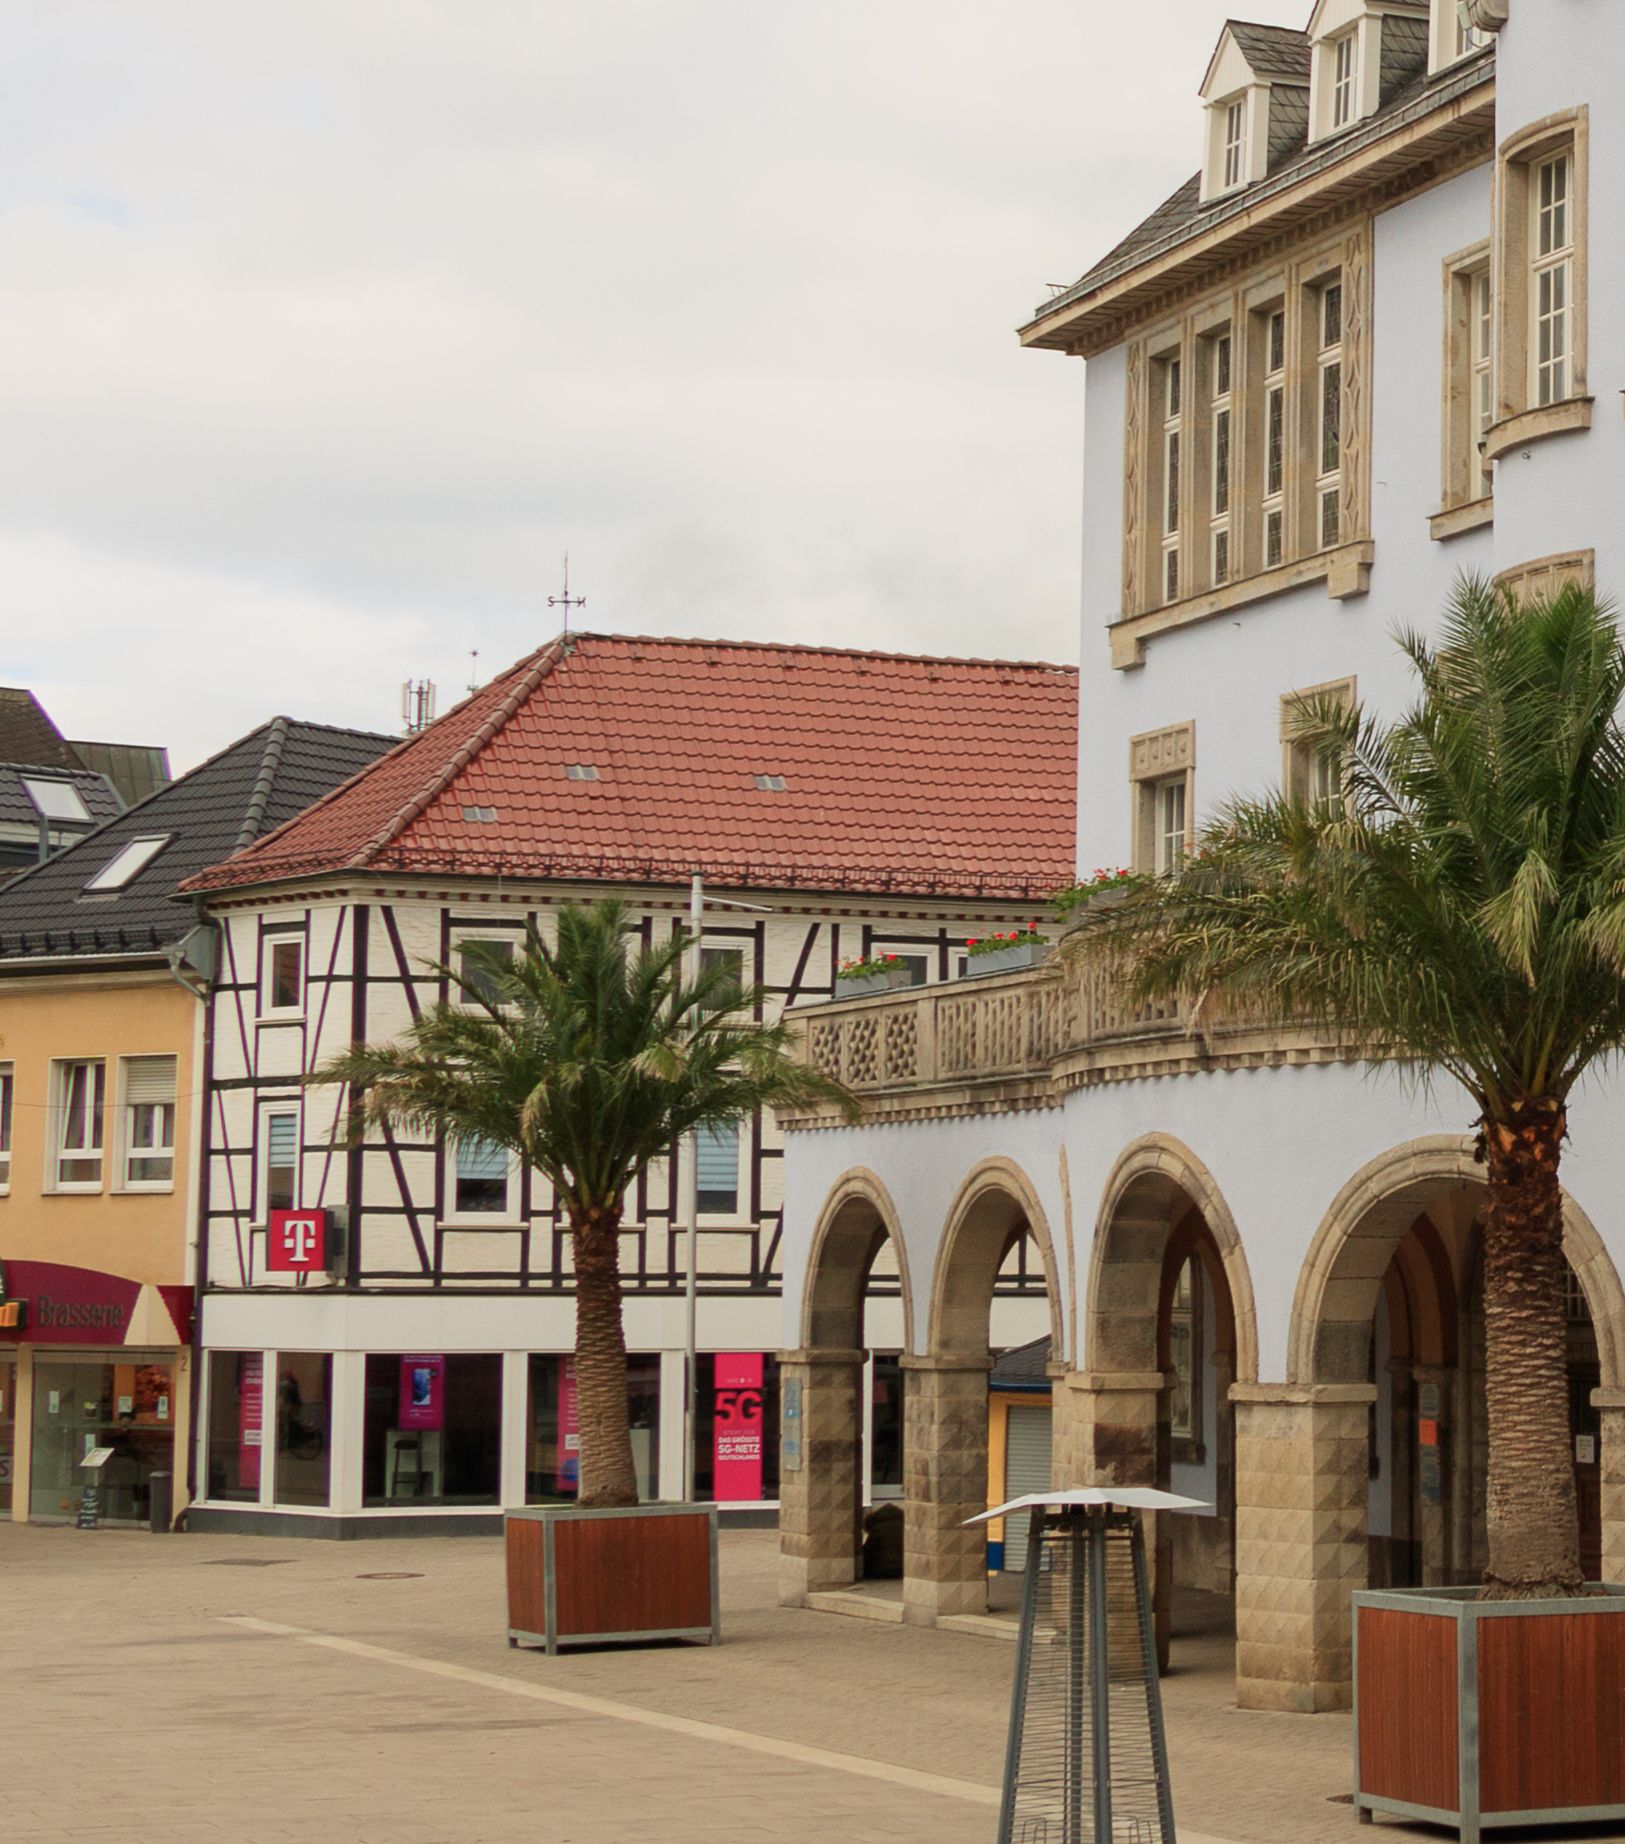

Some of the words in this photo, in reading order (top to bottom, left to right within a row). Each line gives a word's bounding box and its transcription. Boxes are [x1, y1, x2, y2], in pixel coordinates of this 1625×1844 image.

[284, 1220, 316, 1262] T
[38, 1295, 124, 1328] Brasserie
[715, 1390, 763, 1422] 5G
[718, 1444, 760, 1454] 5G-NETZ
